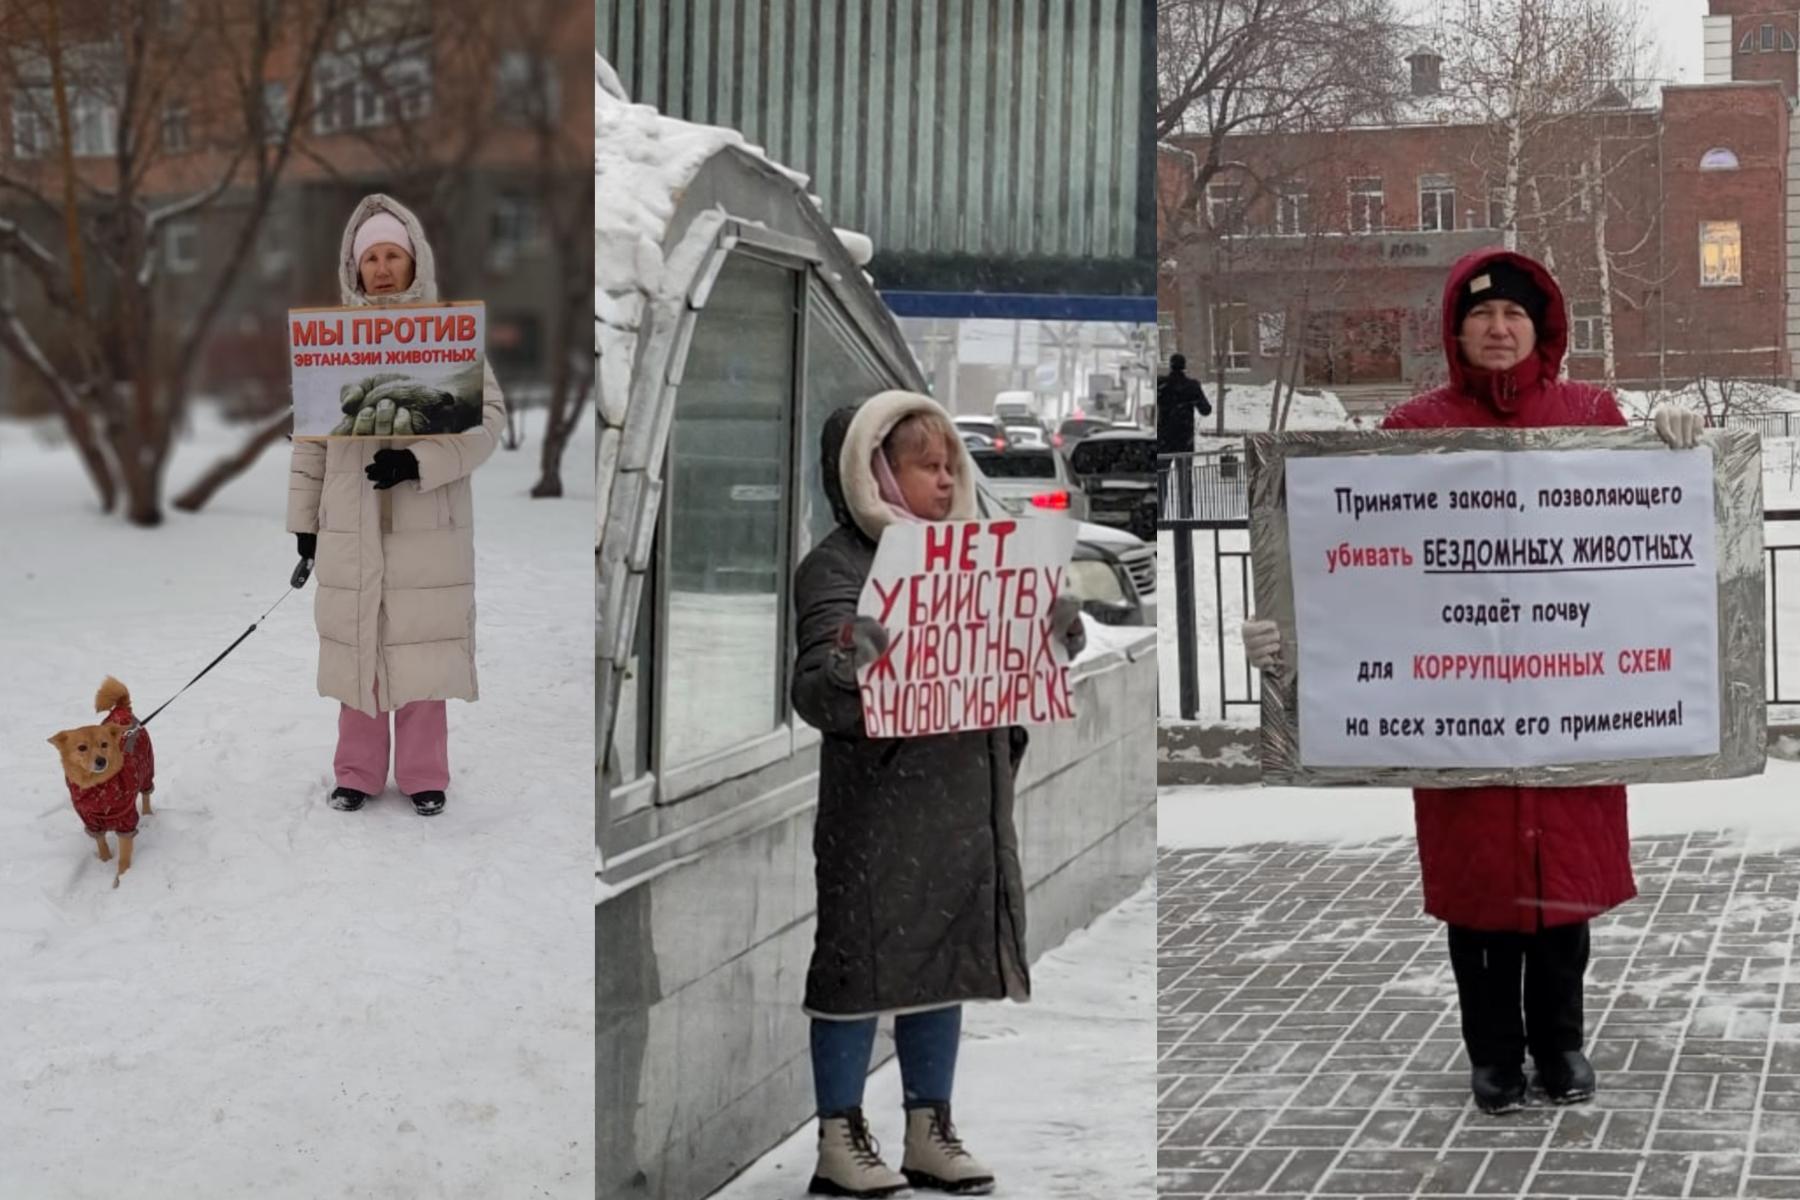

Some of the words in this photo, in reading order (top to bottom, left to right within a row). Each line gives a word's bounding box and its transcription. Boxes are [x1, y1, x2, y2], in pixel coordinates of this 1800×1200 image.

[292, 319, 344, 347] МЫ
[352, 314, 477, 345] ПРОТИВ
[294, 351, 382, 367] ЭВТАНАЗИИ
[385, 347, 477, 365] ЖИВОТНЫХ
[1334, 488, 1438, 520] Принятие
[1449, 490, 1525, 512] закона,
[1538, 486, 1683, 508] позволяющего
[924, 520, 1017, 572] НЕТ
[1326, 542, 1414, 573] убивать
[1423, 538, 1564, 571] БЕЗДОМНЫХ
[1573, 533, 1694, 564] ЖИВОТНЫХ
[872, 565, 1063, 627] УБИЙСТВУ
[1442, 597, 1521, 626] создаёт
[1532, 602, 1590, 628] почву
[866, 619, 1056, 681] ЖИВОТНЫХ
[1357, 661, 1393, 682] для
[1413, 651, 1605, 683] КОРРУПЦИОННЫХ
[1618, 648, 1672, 674] СХЕМ
[1346, 717, 1369, 737] на
[1379, 717, 1425, 736] всех
[1435, 717, 1505, 737] этапах
[1515, 716, 1549, 735] его
[1560, 700, 1683, 741] применения!
